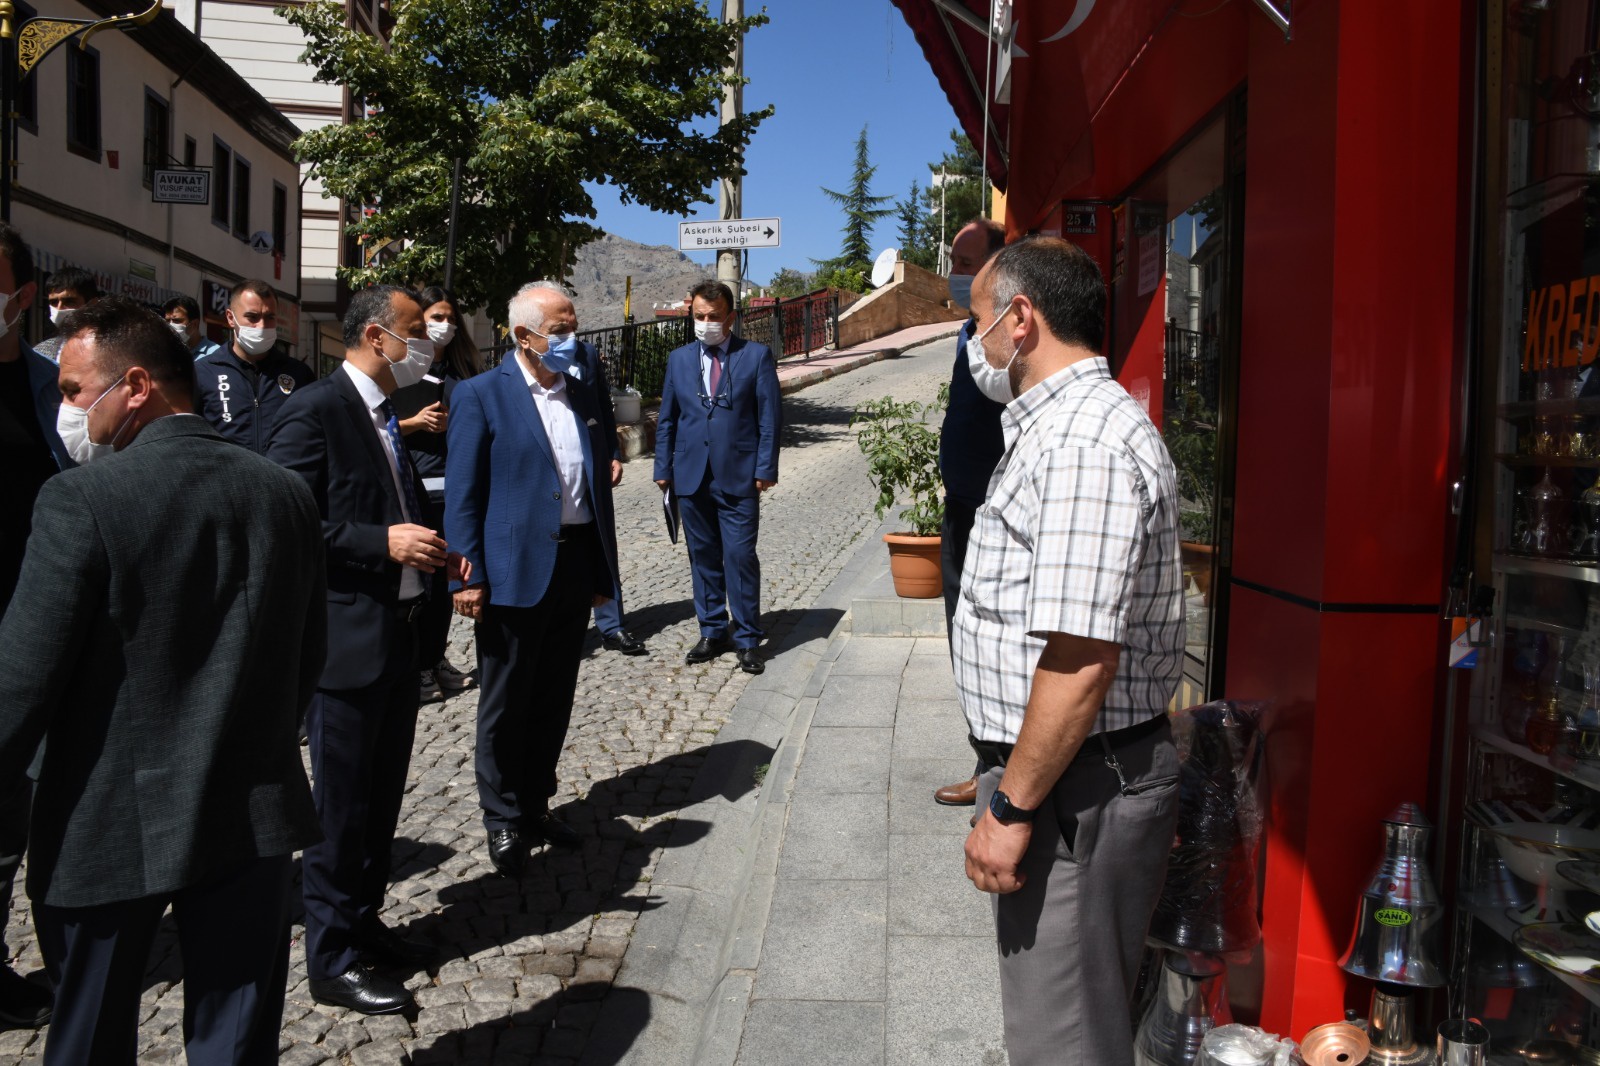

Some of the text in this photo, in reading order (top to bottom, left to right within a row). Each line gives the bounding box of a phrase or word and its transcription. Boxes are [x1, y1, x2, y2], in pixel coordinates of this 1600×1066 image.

[159, 175, 203, 185] AVUKAT
[159, 184, 183, 192] YUSUF
[1066, 213, 1096, 227] 25 A
[684, 224, 760, 235] Askerlik Şubesi
[697, 235, 748, 246] Başkanlığı
